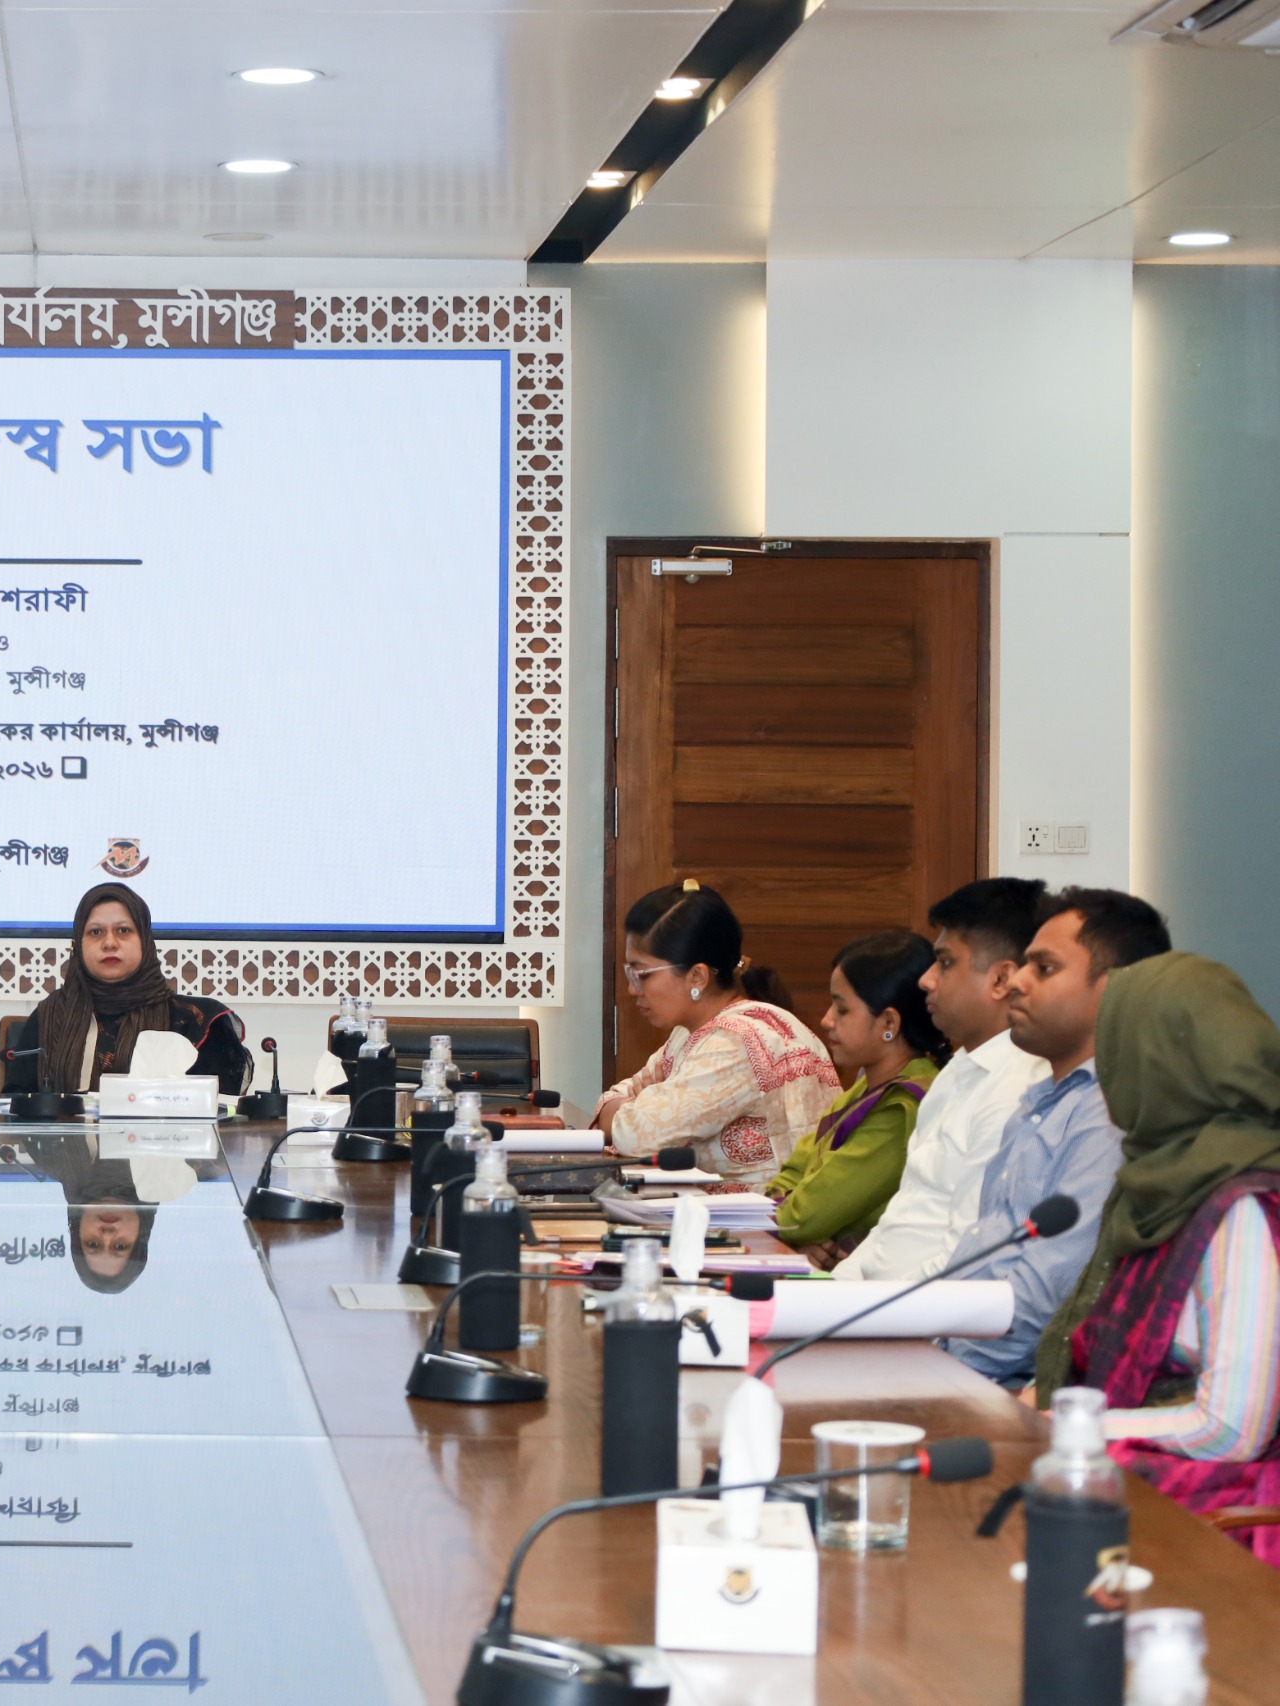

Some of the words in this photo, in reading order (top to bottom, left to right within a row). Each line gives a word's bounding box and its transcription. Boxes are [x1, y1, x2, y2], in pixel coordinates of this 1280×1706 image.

[132, 284, 277, 347] মুন্সীগঞ্জ
[82, 412, 222, 474] সভা
[6, 666, 85, 694] মুন্সীগঞ্জ
[39, 717, 132, 745] কার্যালয়,
[139, 719, 219, 748] মুন্সীগঞ্জ
